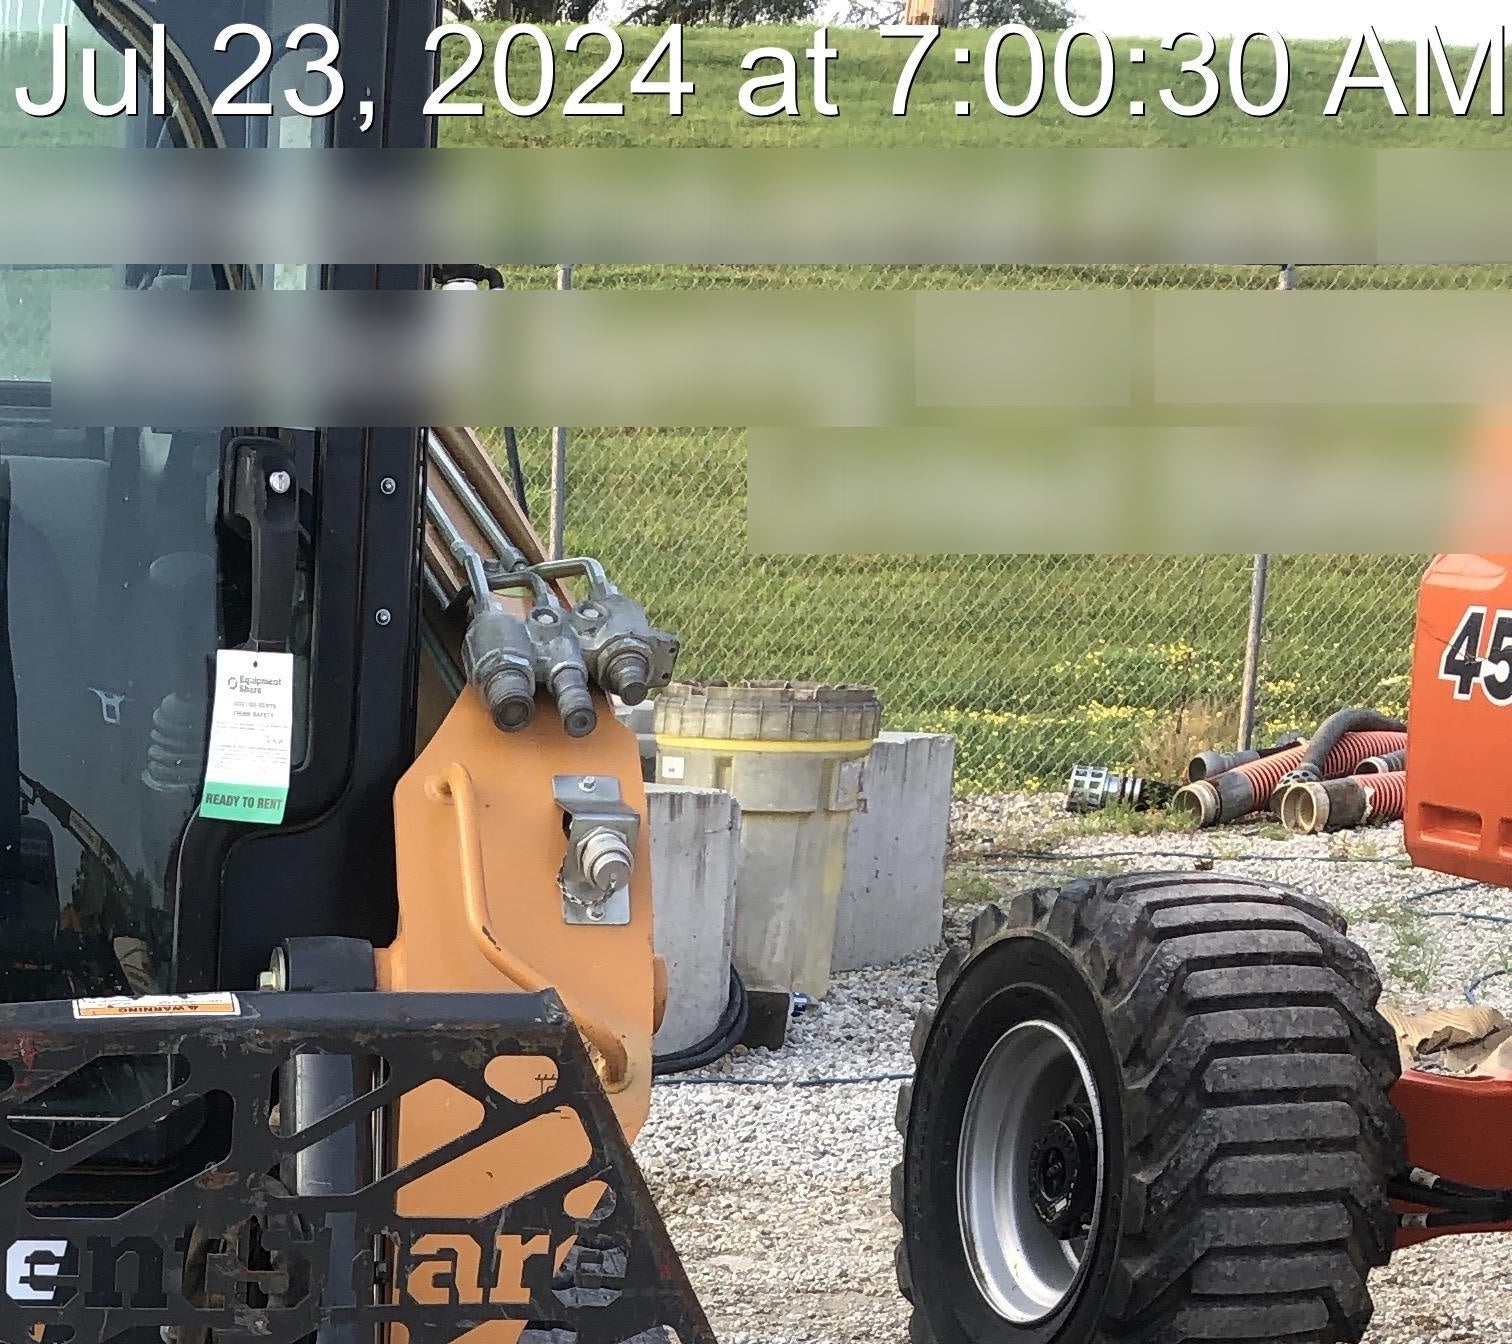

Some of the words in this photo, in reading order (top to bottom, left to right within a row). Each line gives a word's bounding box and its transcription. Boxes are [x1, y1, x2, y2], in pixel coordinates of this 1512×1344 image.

[205, 792, 240, 808] READY
[242, 796, 255, 809] TO
[256, 797, 283, 811] RENT
